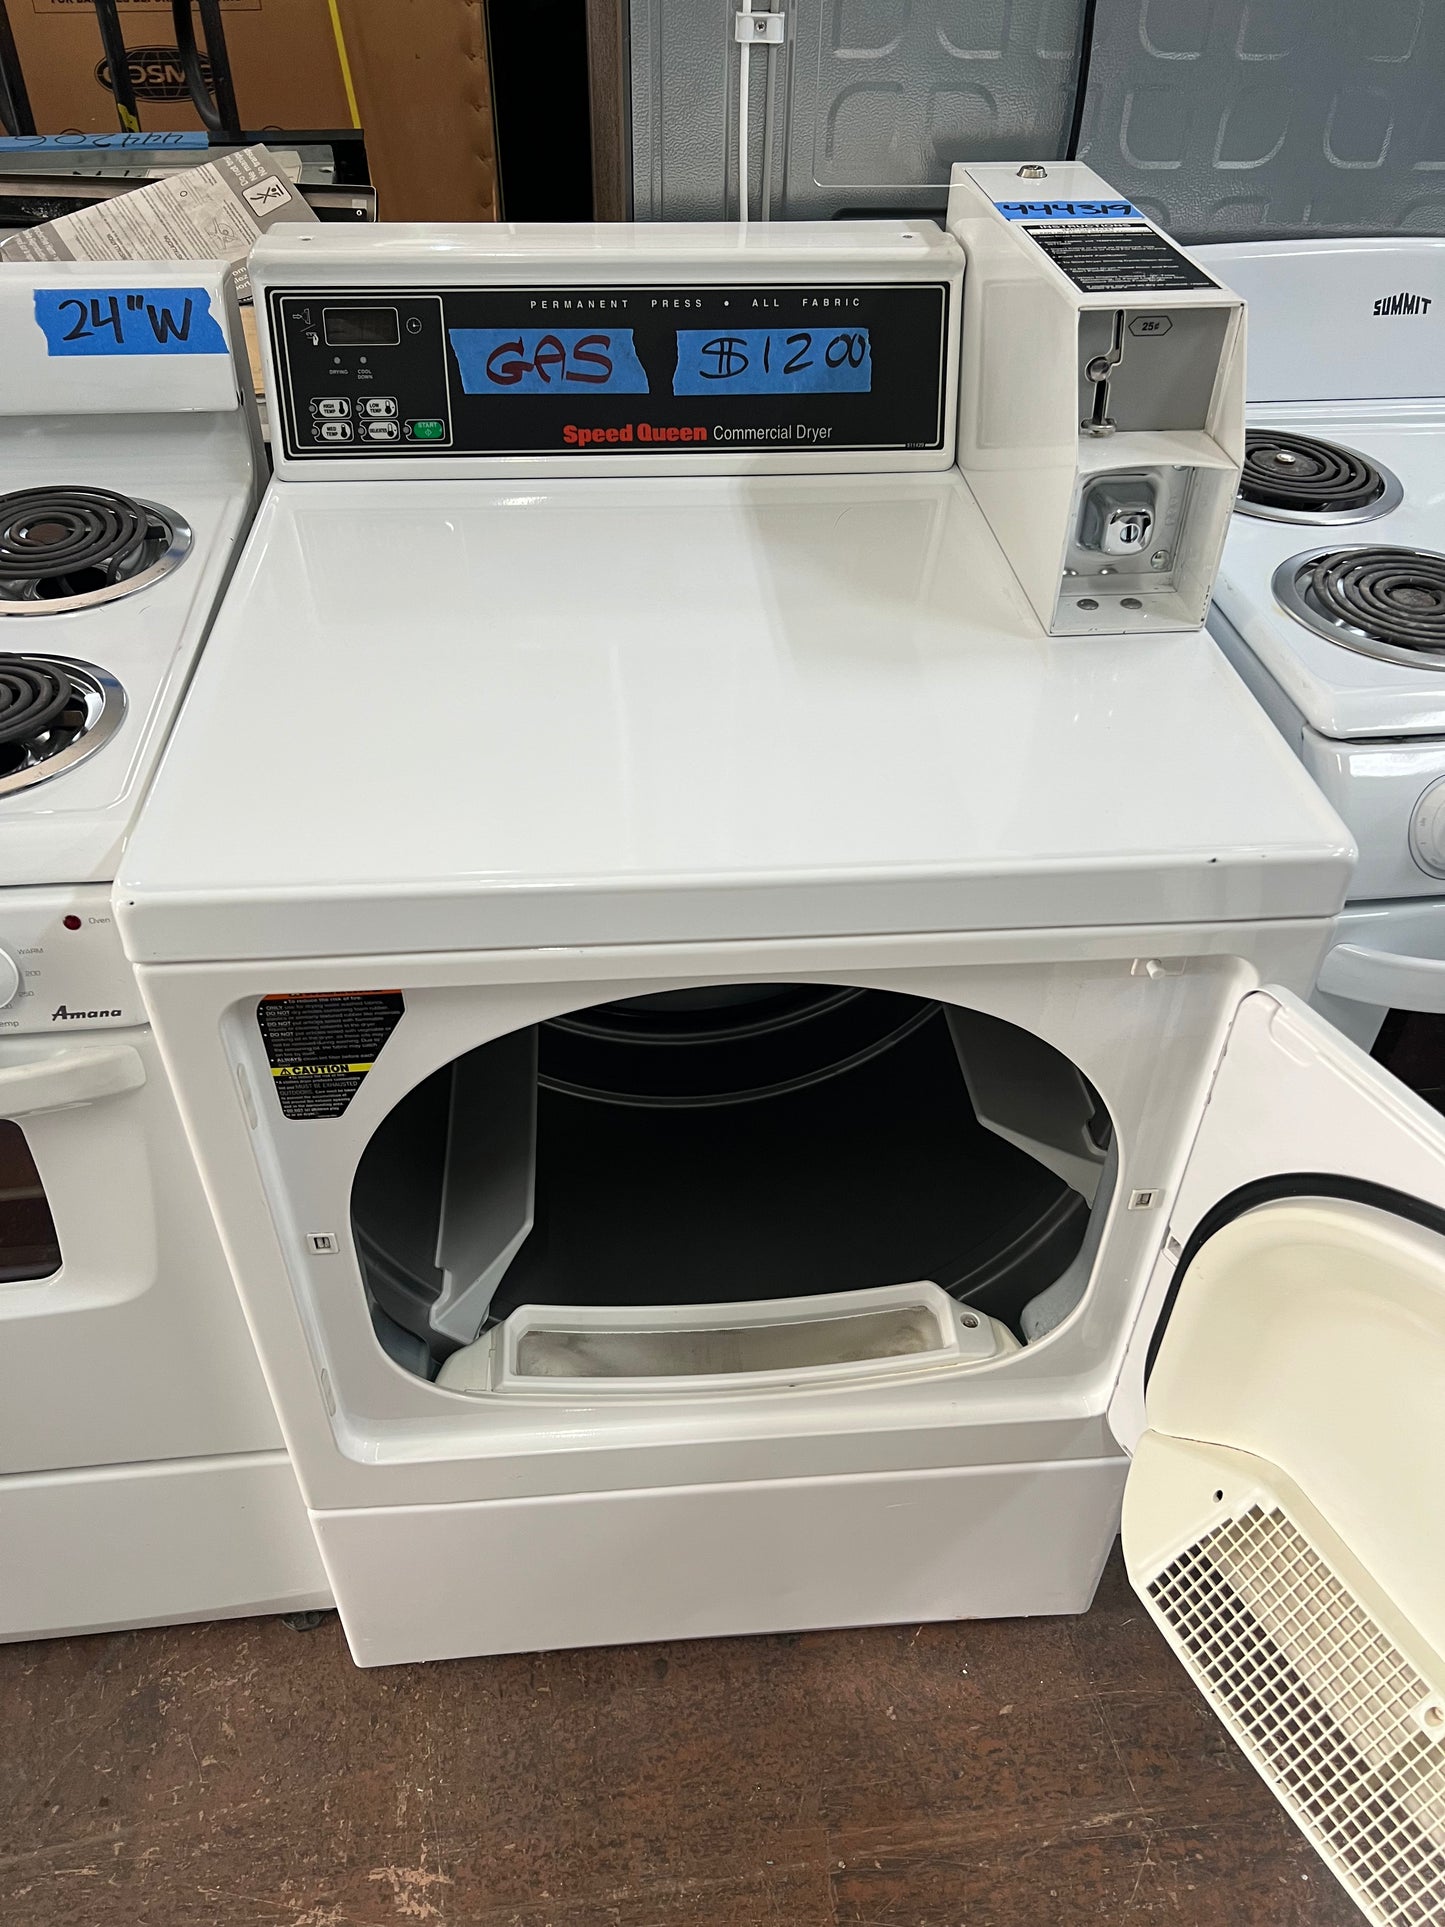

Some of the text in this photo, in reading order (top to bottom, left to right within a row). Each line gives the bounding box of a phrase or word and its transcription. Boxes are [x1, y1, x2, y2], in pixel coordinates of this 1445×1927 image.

[1003, 203, 1132, 216] 444319
[530, 298, 860, 310] PERMANENT PRESS ALL FABRIC
[1373, 292, 1432, 316] SUMMIT
[486, 334, 613, 385] GAS
[700, 332, 866, 379] $1200
[563, 423, 833, 444] Speed Queen Commercial Dryer
[88, 917, 111, 925] Oven
[52, 1005, 122, 1021] Amana
[292, 1065, 350, 1075] CAUTION
